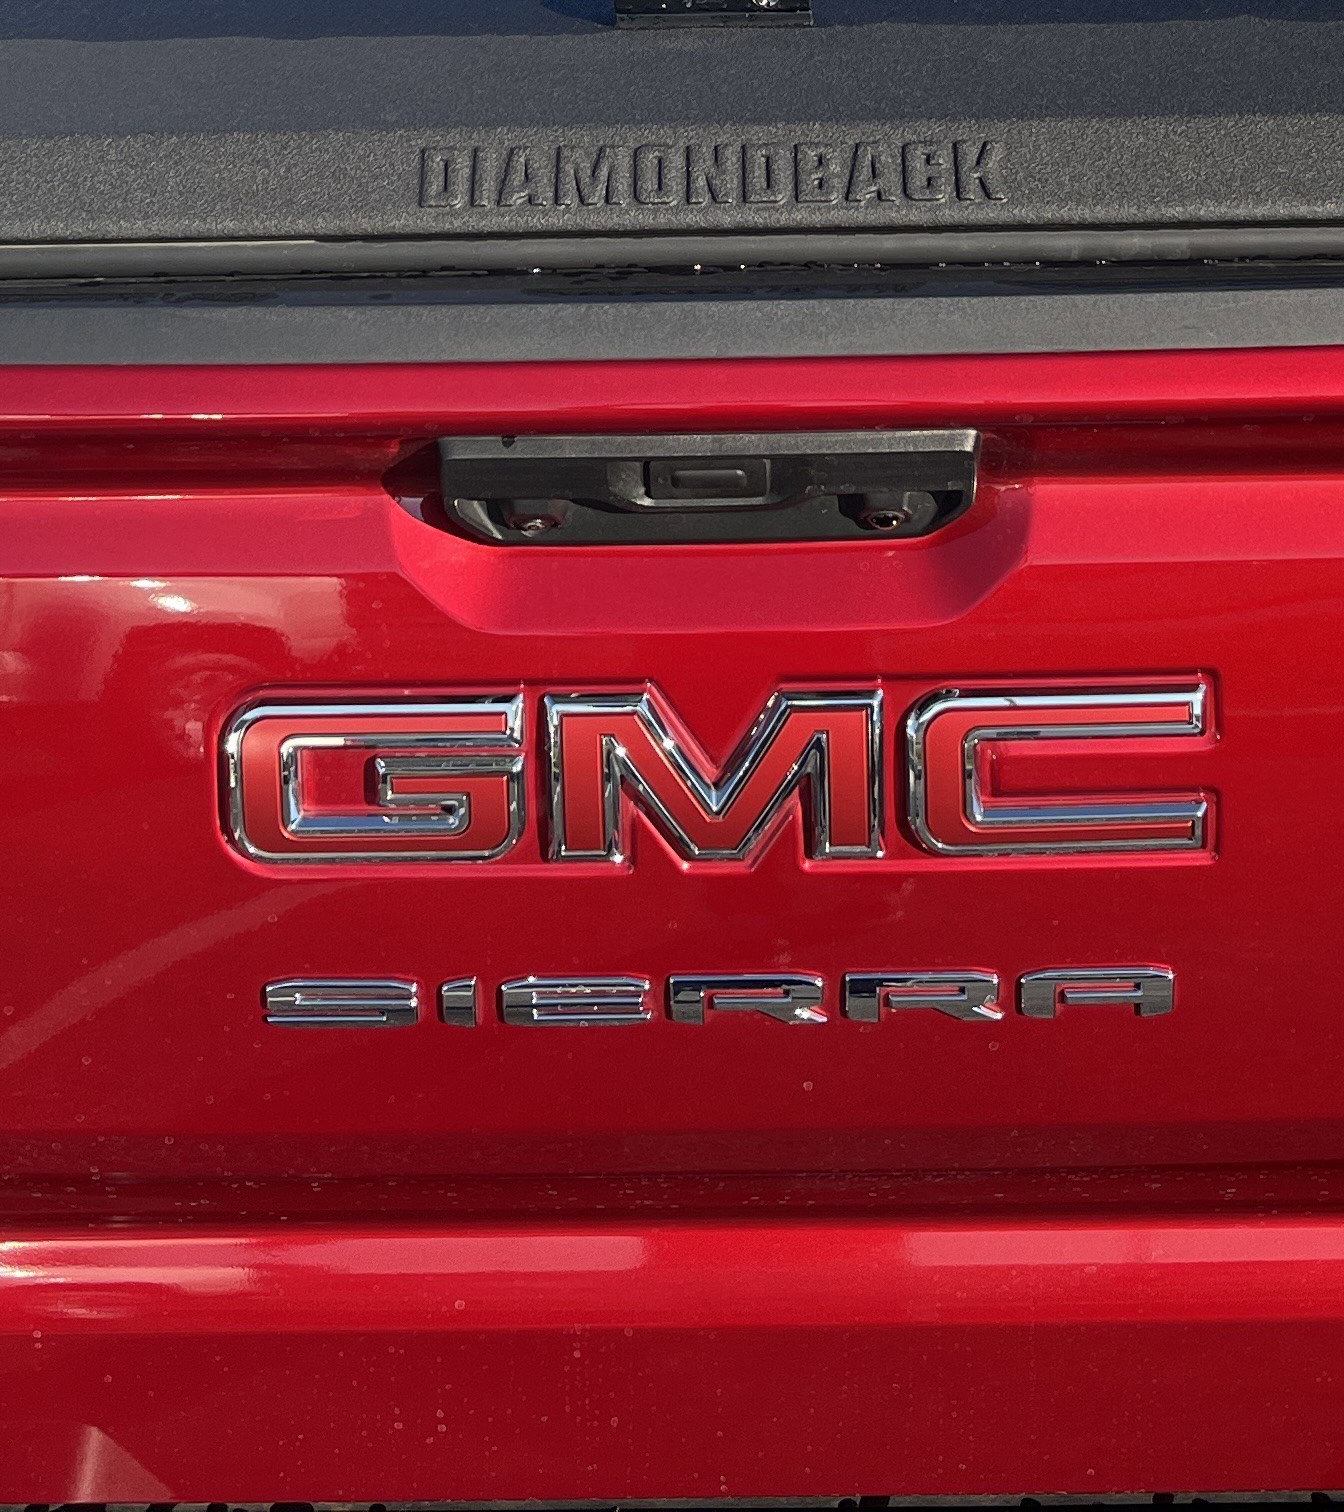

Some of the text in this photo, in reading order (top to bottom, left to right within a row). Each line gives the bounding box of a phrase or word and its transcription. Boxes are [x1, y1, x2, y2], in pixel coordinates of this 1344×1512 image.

[418, 138, 1010, 209] DIAMONDBACK
[223, 679, 1214, 870] GMC
[263, 970, 1177, 1028] SIERRA
